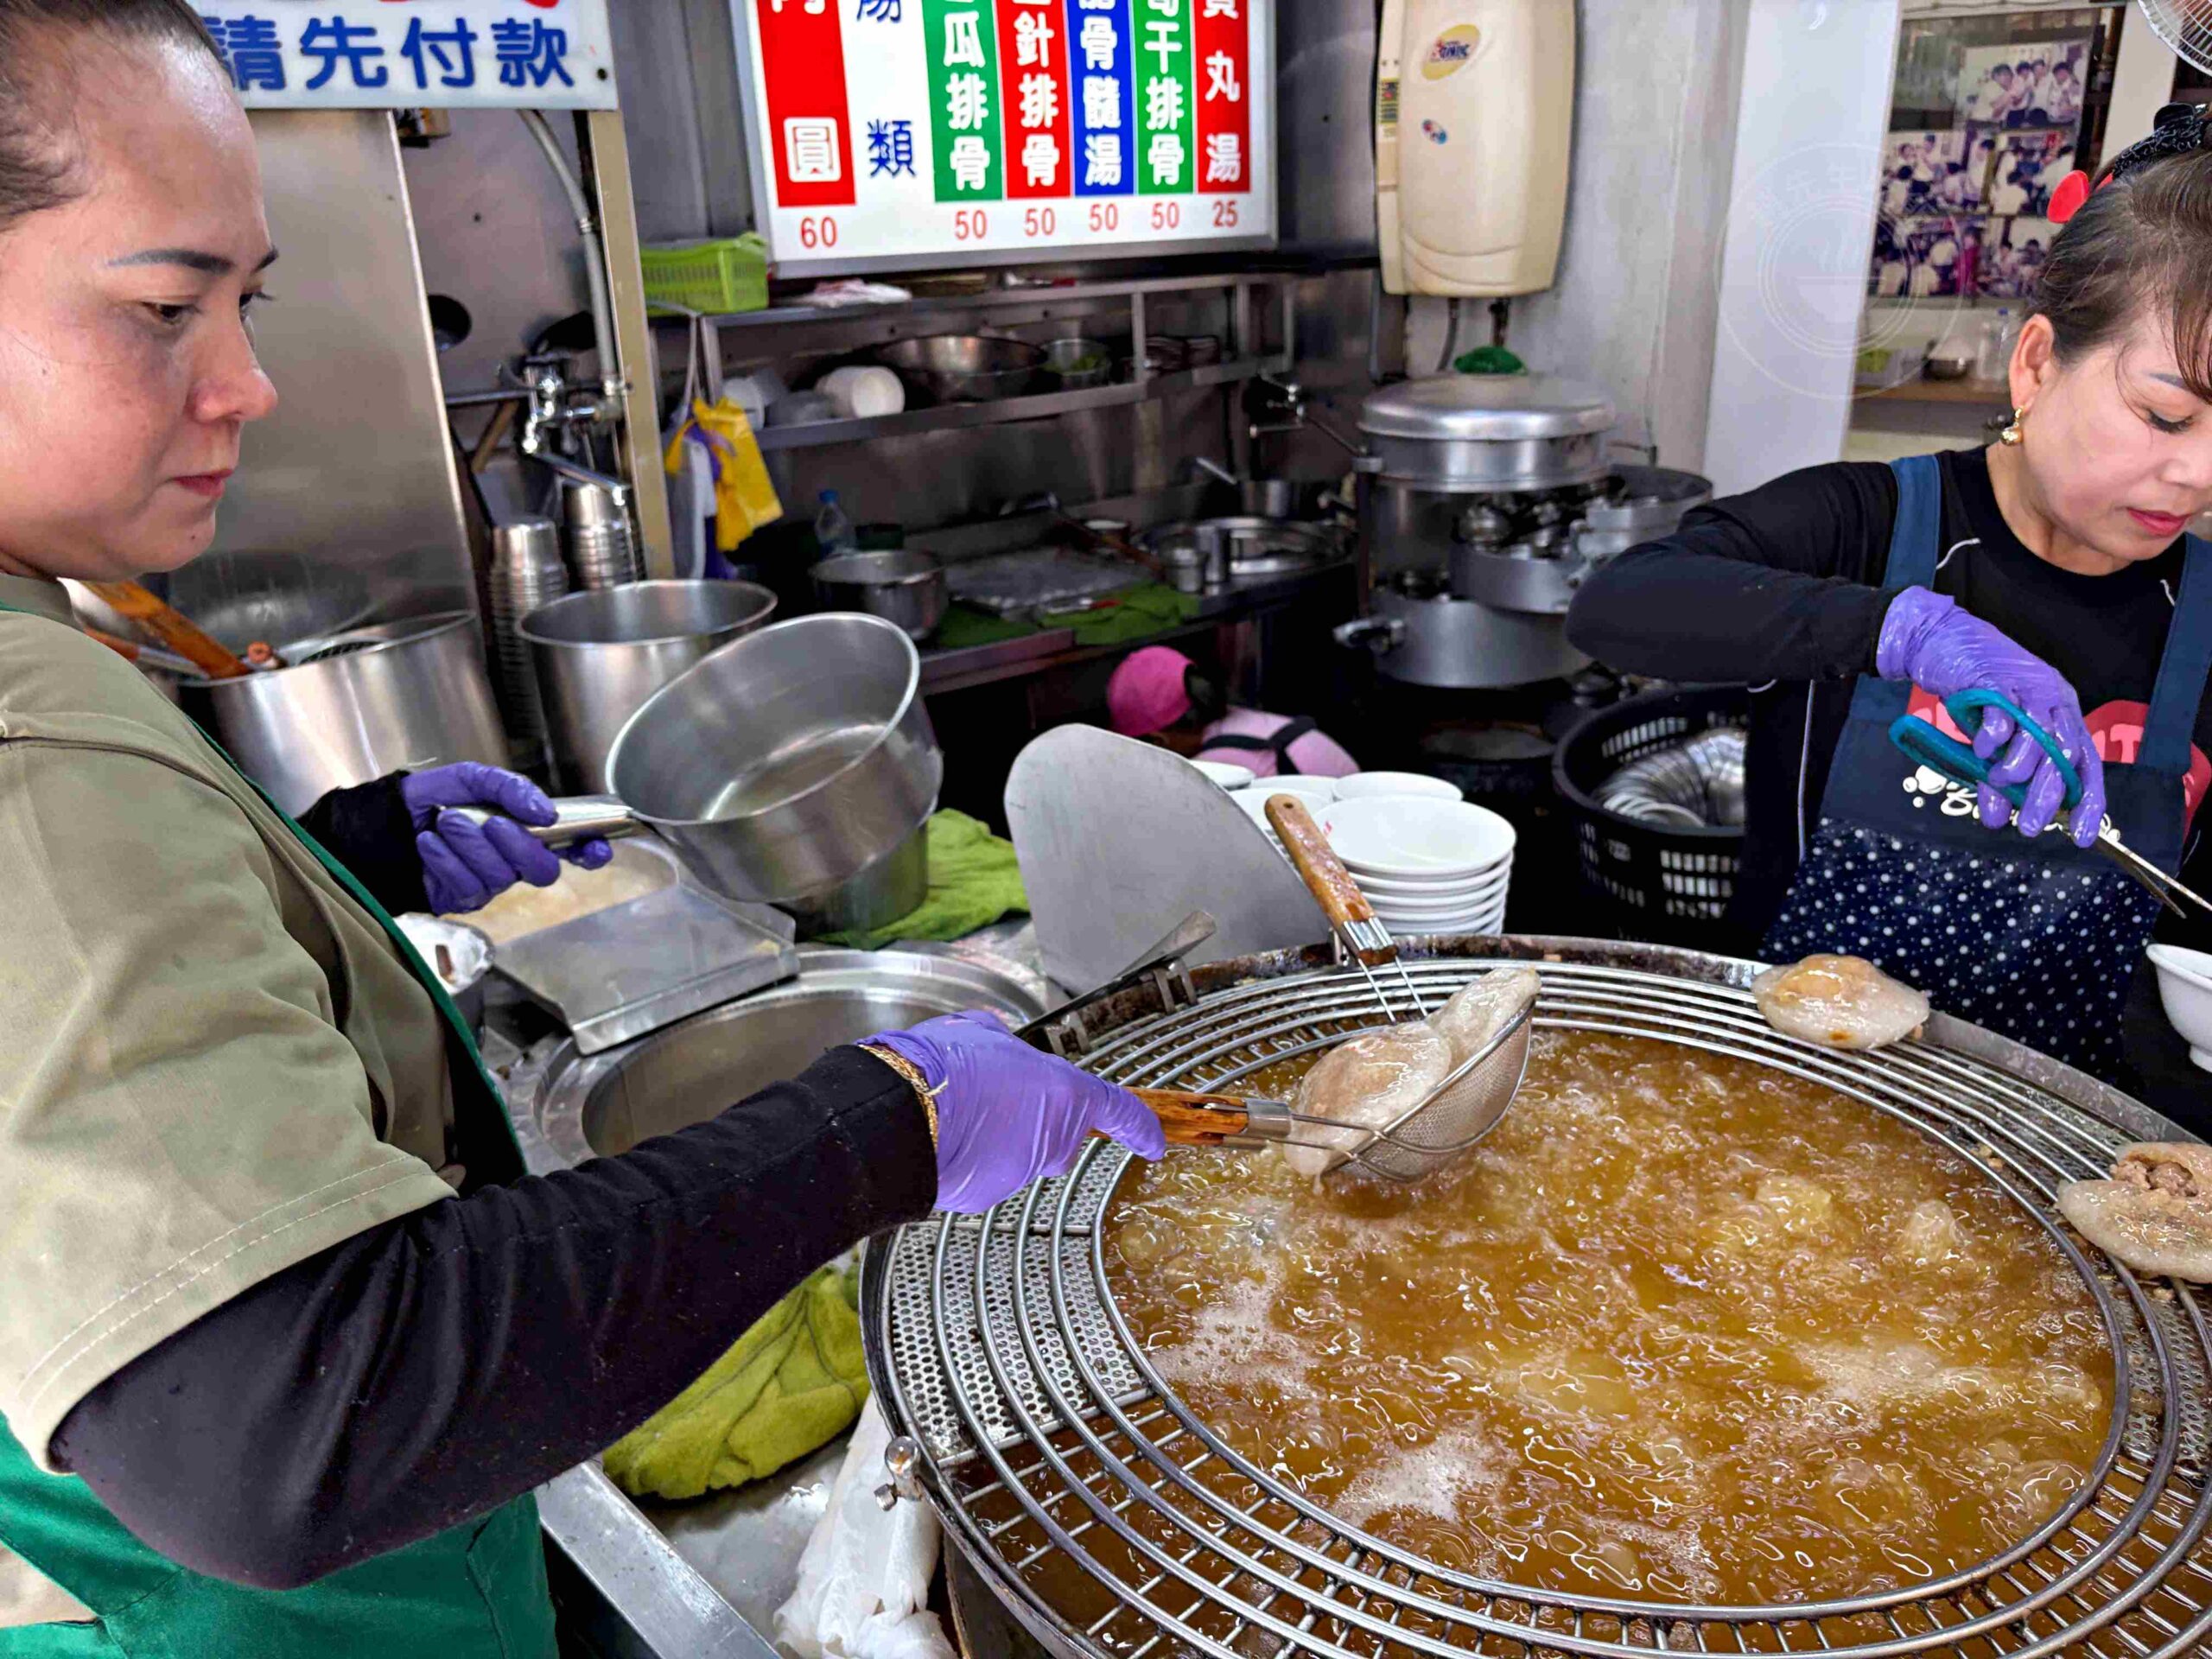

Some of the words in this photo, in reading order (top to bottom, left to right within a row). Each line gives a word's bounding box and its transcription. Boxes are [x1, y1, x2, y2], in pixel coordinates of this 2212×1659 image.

[201, 16, 574, 90] 請先付款
[771, 0, 842, 182] 圓
[944, 0, 990, 191] 瓜排骨
[1012, 0, 1060, 187] 針排骨
[1077, 0, 1122, 186] 骨髓湯
[955, 209, 988, 240] 50
[1024, 207, 1056, 237] 50
[1089, 202, 1119, 232] 50
[1151, 201, 1180, 230] 50
[1212, 200, 1238, 228] 25
[801, 216, 838, 249] 60
